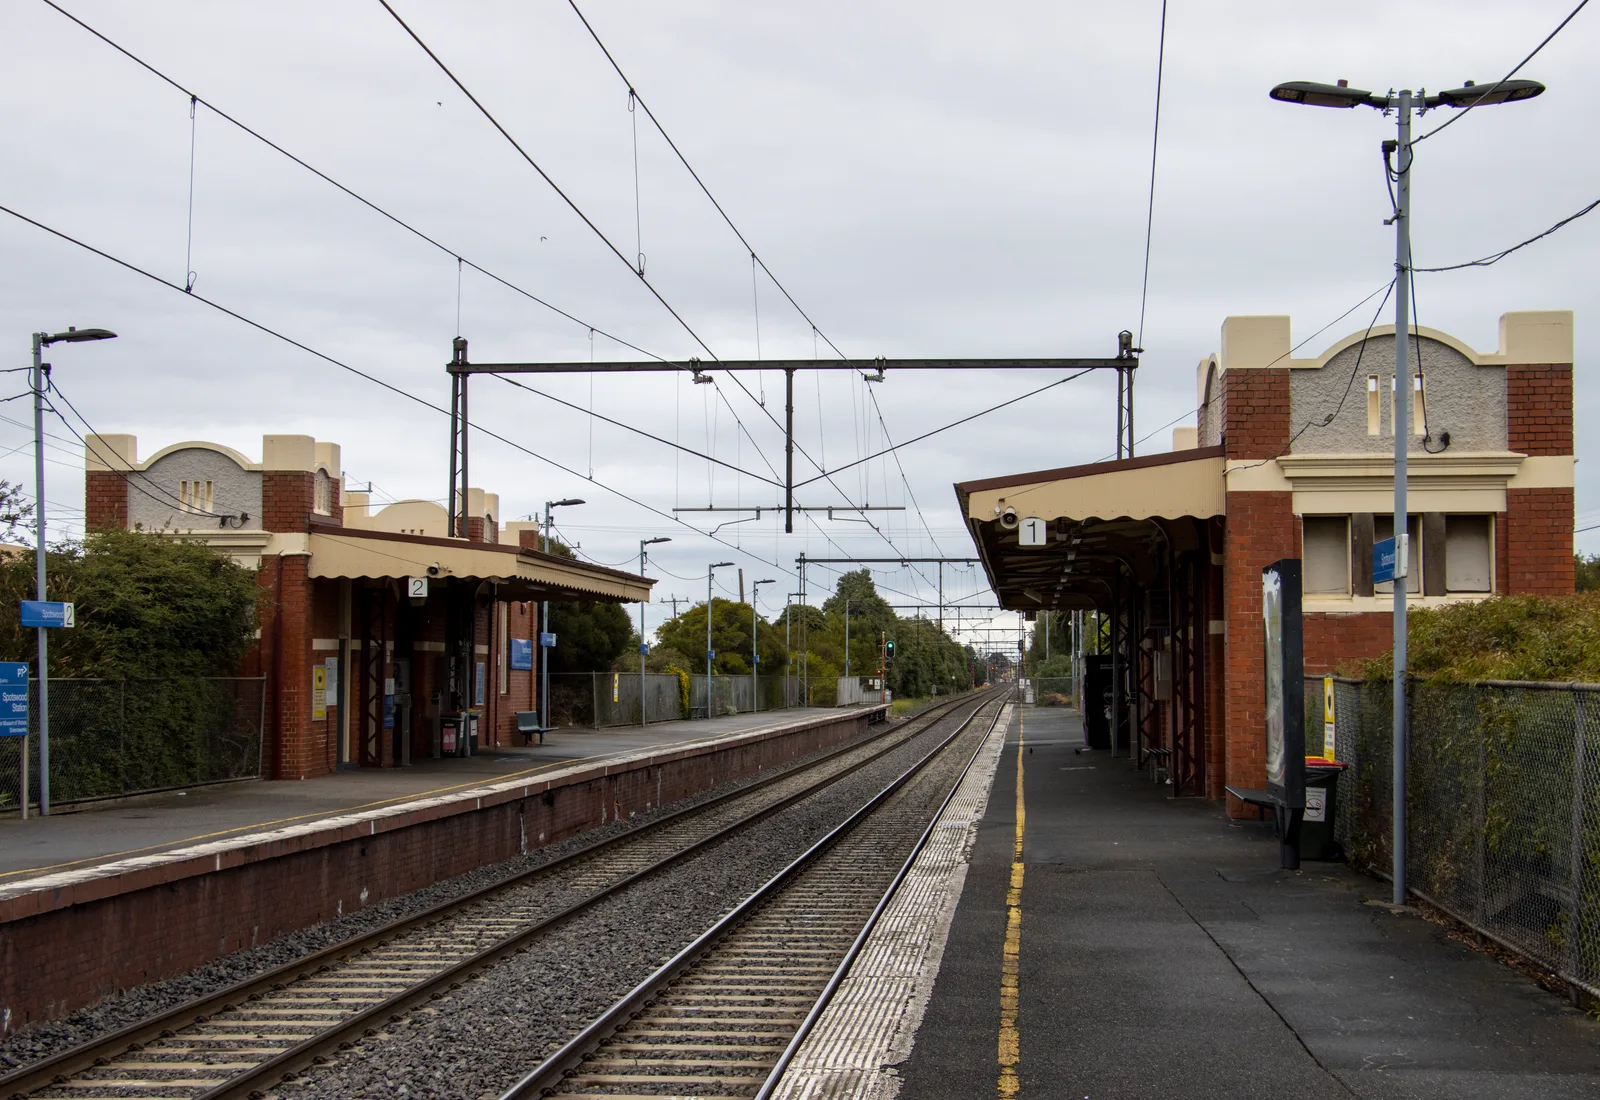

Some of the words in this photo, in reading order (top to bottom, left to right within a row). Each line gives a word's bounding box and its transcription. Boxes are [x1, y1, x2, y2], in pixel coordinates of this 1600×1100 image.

[1027, 521, 1036, 543] 1
[412, 579, 424, 596] 2
[42, 609, 64, 619] Spotswood
[66, 605, 73, 625] 2
[2, 692, 28, 703] Spotswood
[12, 703, 27, 712] Station
